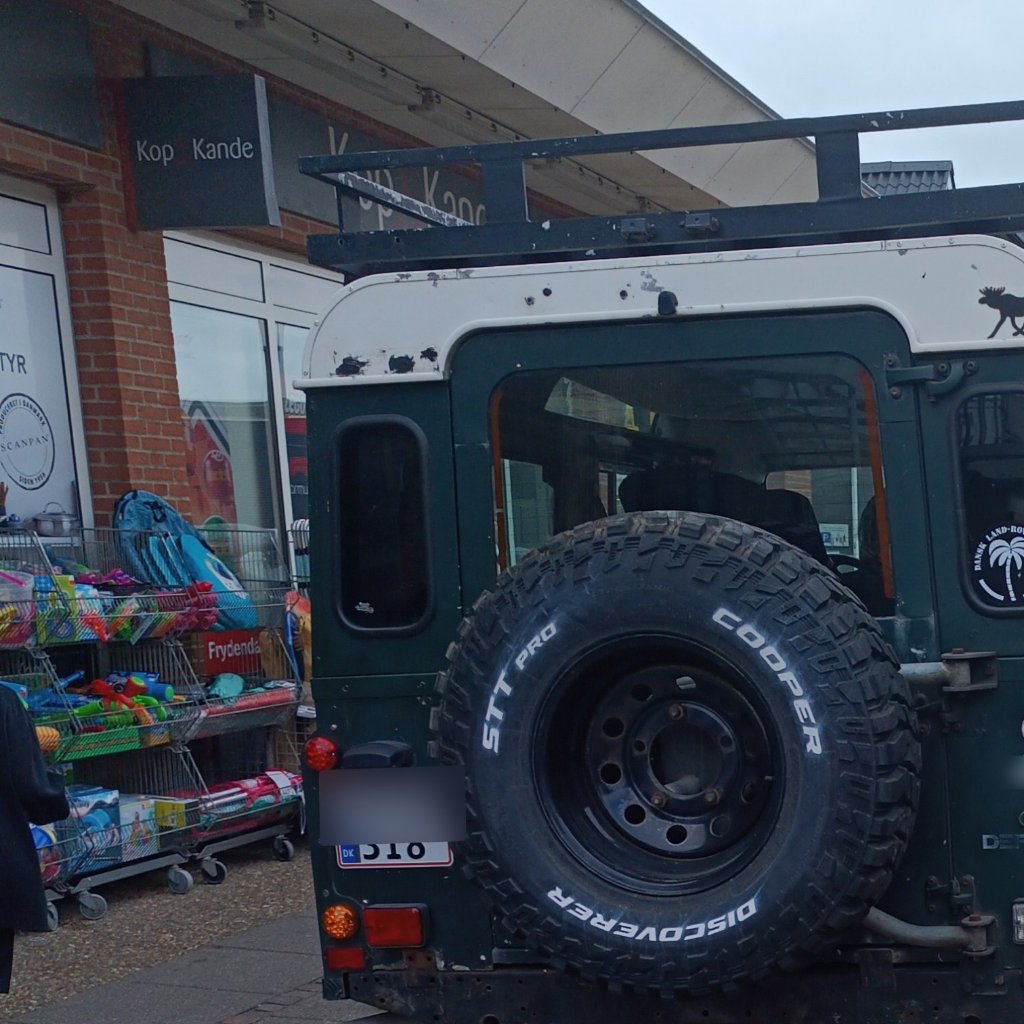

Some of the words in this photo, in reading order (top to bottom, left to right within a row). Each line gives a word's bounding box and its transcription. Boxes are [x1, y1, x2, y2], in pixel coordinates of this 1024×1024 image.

[136, 140, 175, 167] Kop
[192, 136, 254, 160] Kande
[0, 435, 49, 452] SCANPAN
[973, 541, 988, 571] DANSK
[482, 669, 512, 754] STT
[515, 622, 557, 670] PRO
[712, 607, 822, 755] COOPER
[343, 849, 354, 857] DK
[547, 886, 758, 943] DISCOVERER
